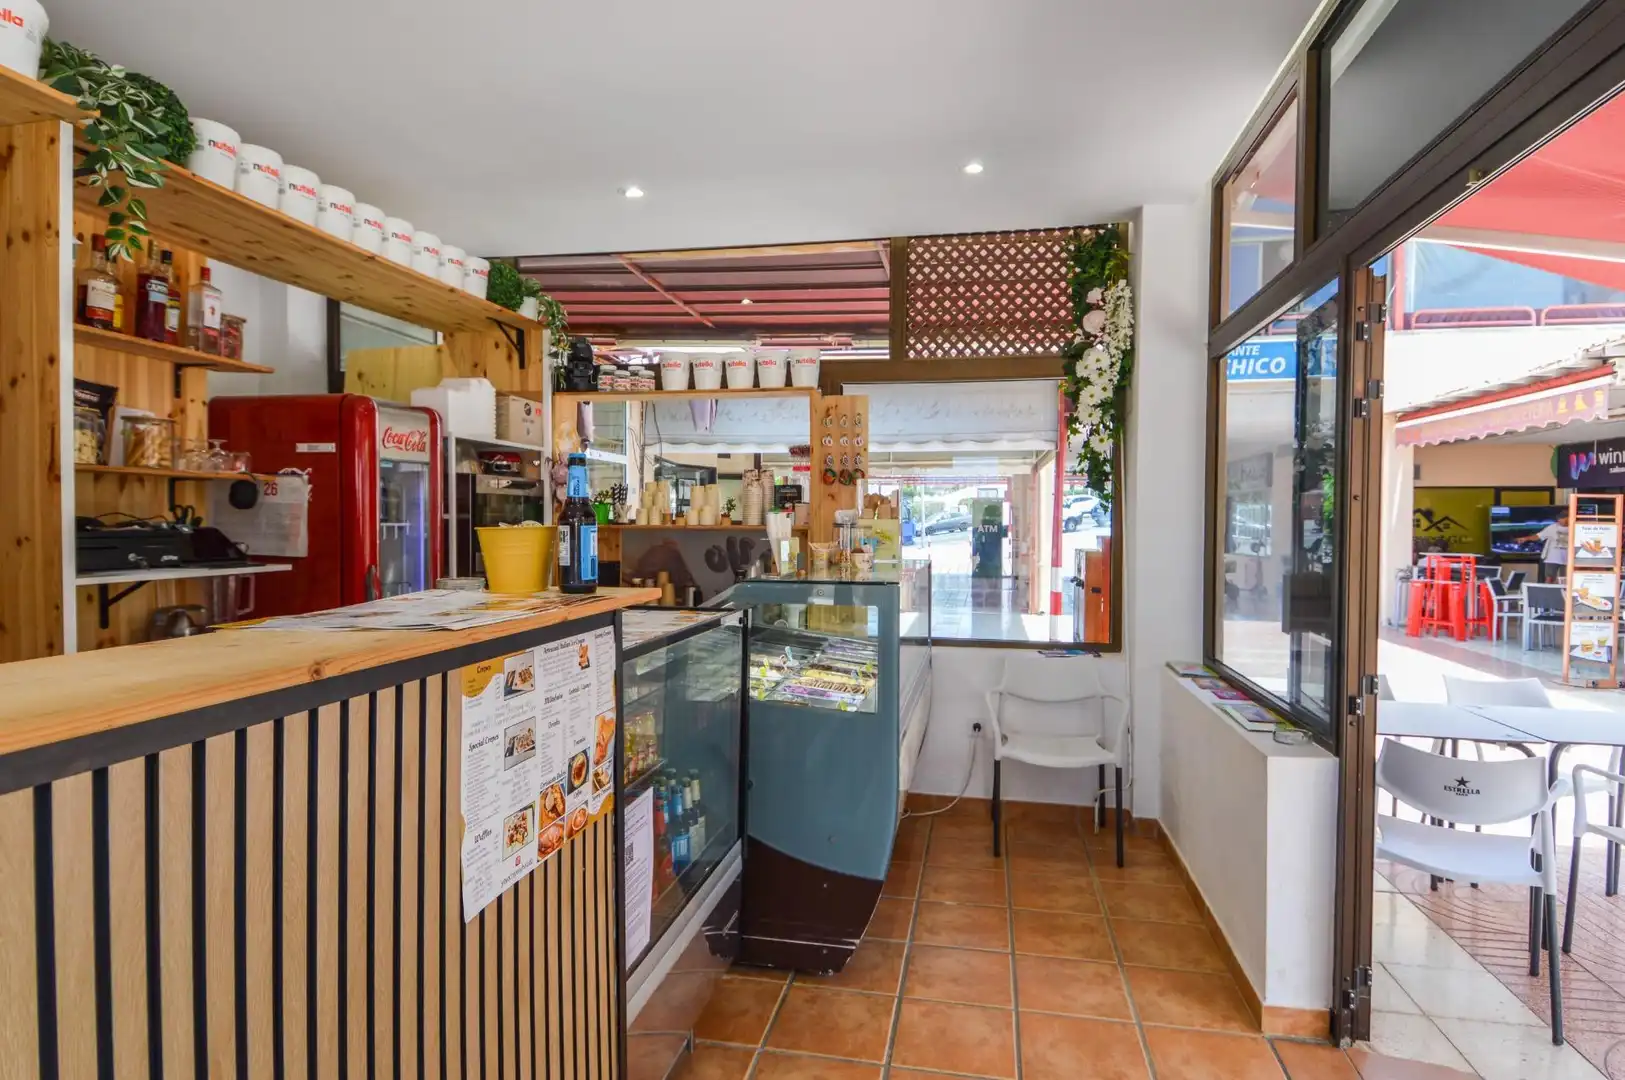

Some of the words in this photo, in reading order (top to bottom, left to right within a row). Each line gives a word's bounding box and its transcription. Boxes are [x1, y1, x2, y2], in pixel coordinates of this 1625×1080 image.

[263, 481, 279, 497] 26
[977, 524, 998, 533] ATM
[468, 737, 485, 752] Special
[484, 734, 499, 745] Crepes
[1443, 785, 1481, 795] ESTRELLA
